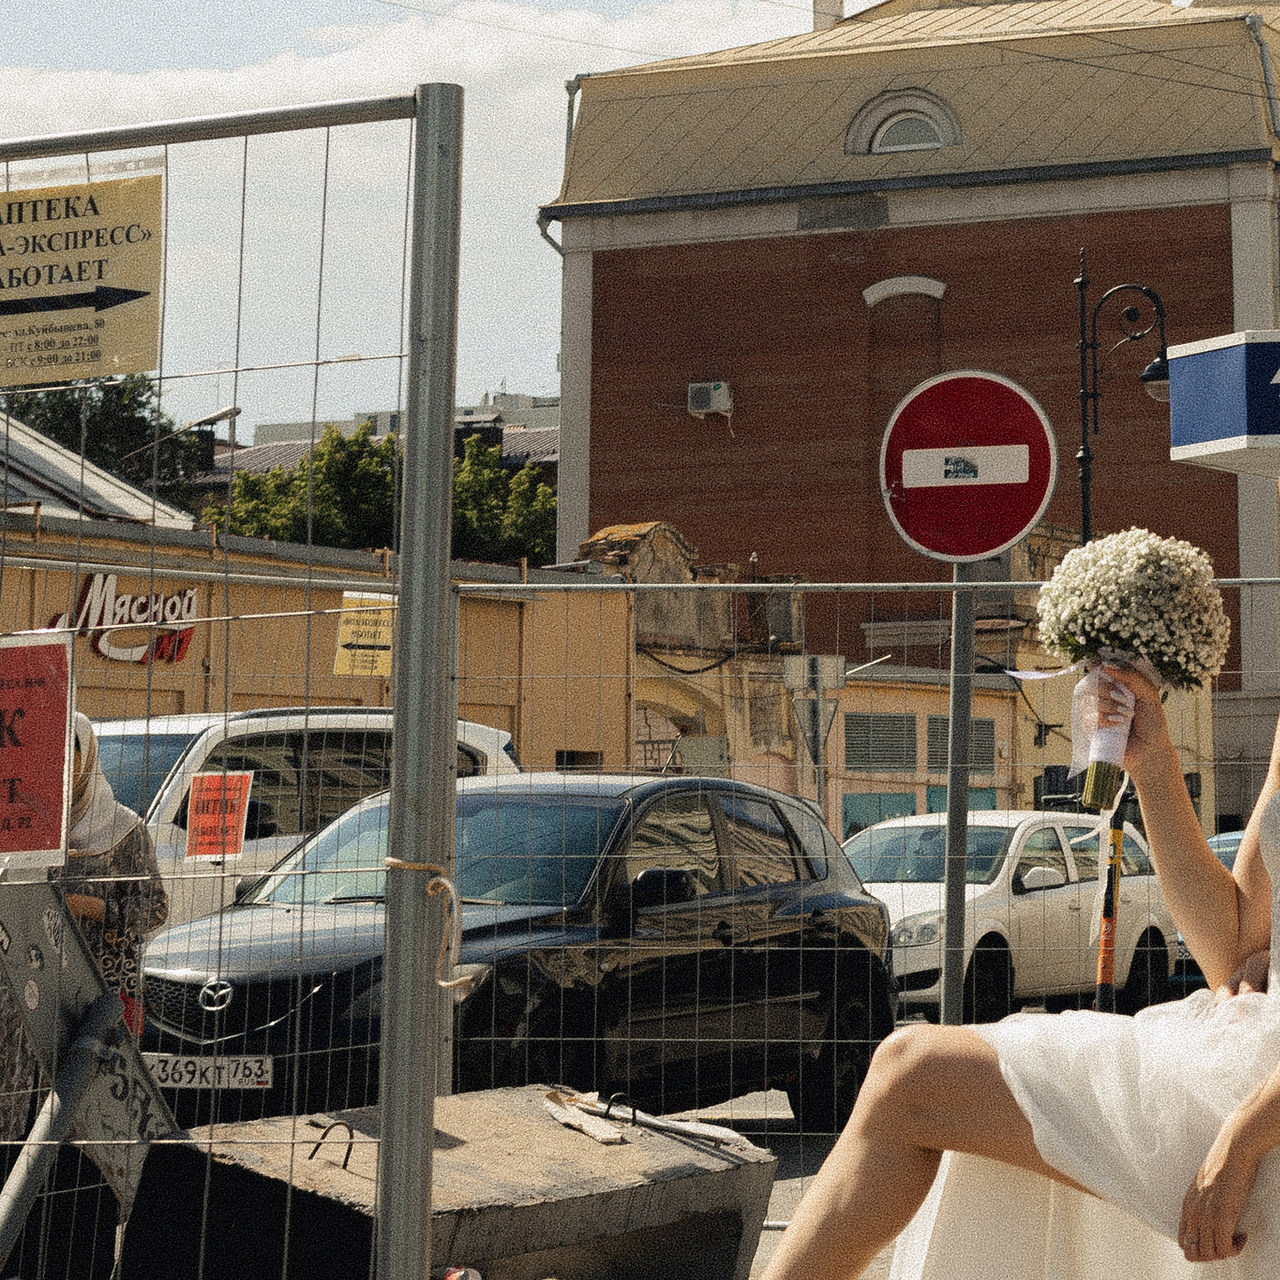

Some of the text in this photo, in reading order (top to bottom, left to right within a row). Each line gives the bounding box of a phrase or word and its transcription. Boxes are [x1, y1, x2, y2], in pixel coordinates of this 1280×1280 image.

[75, 573, 197, 638] Мясной
[149, 1059, 265, 1085] 369КТ 763
